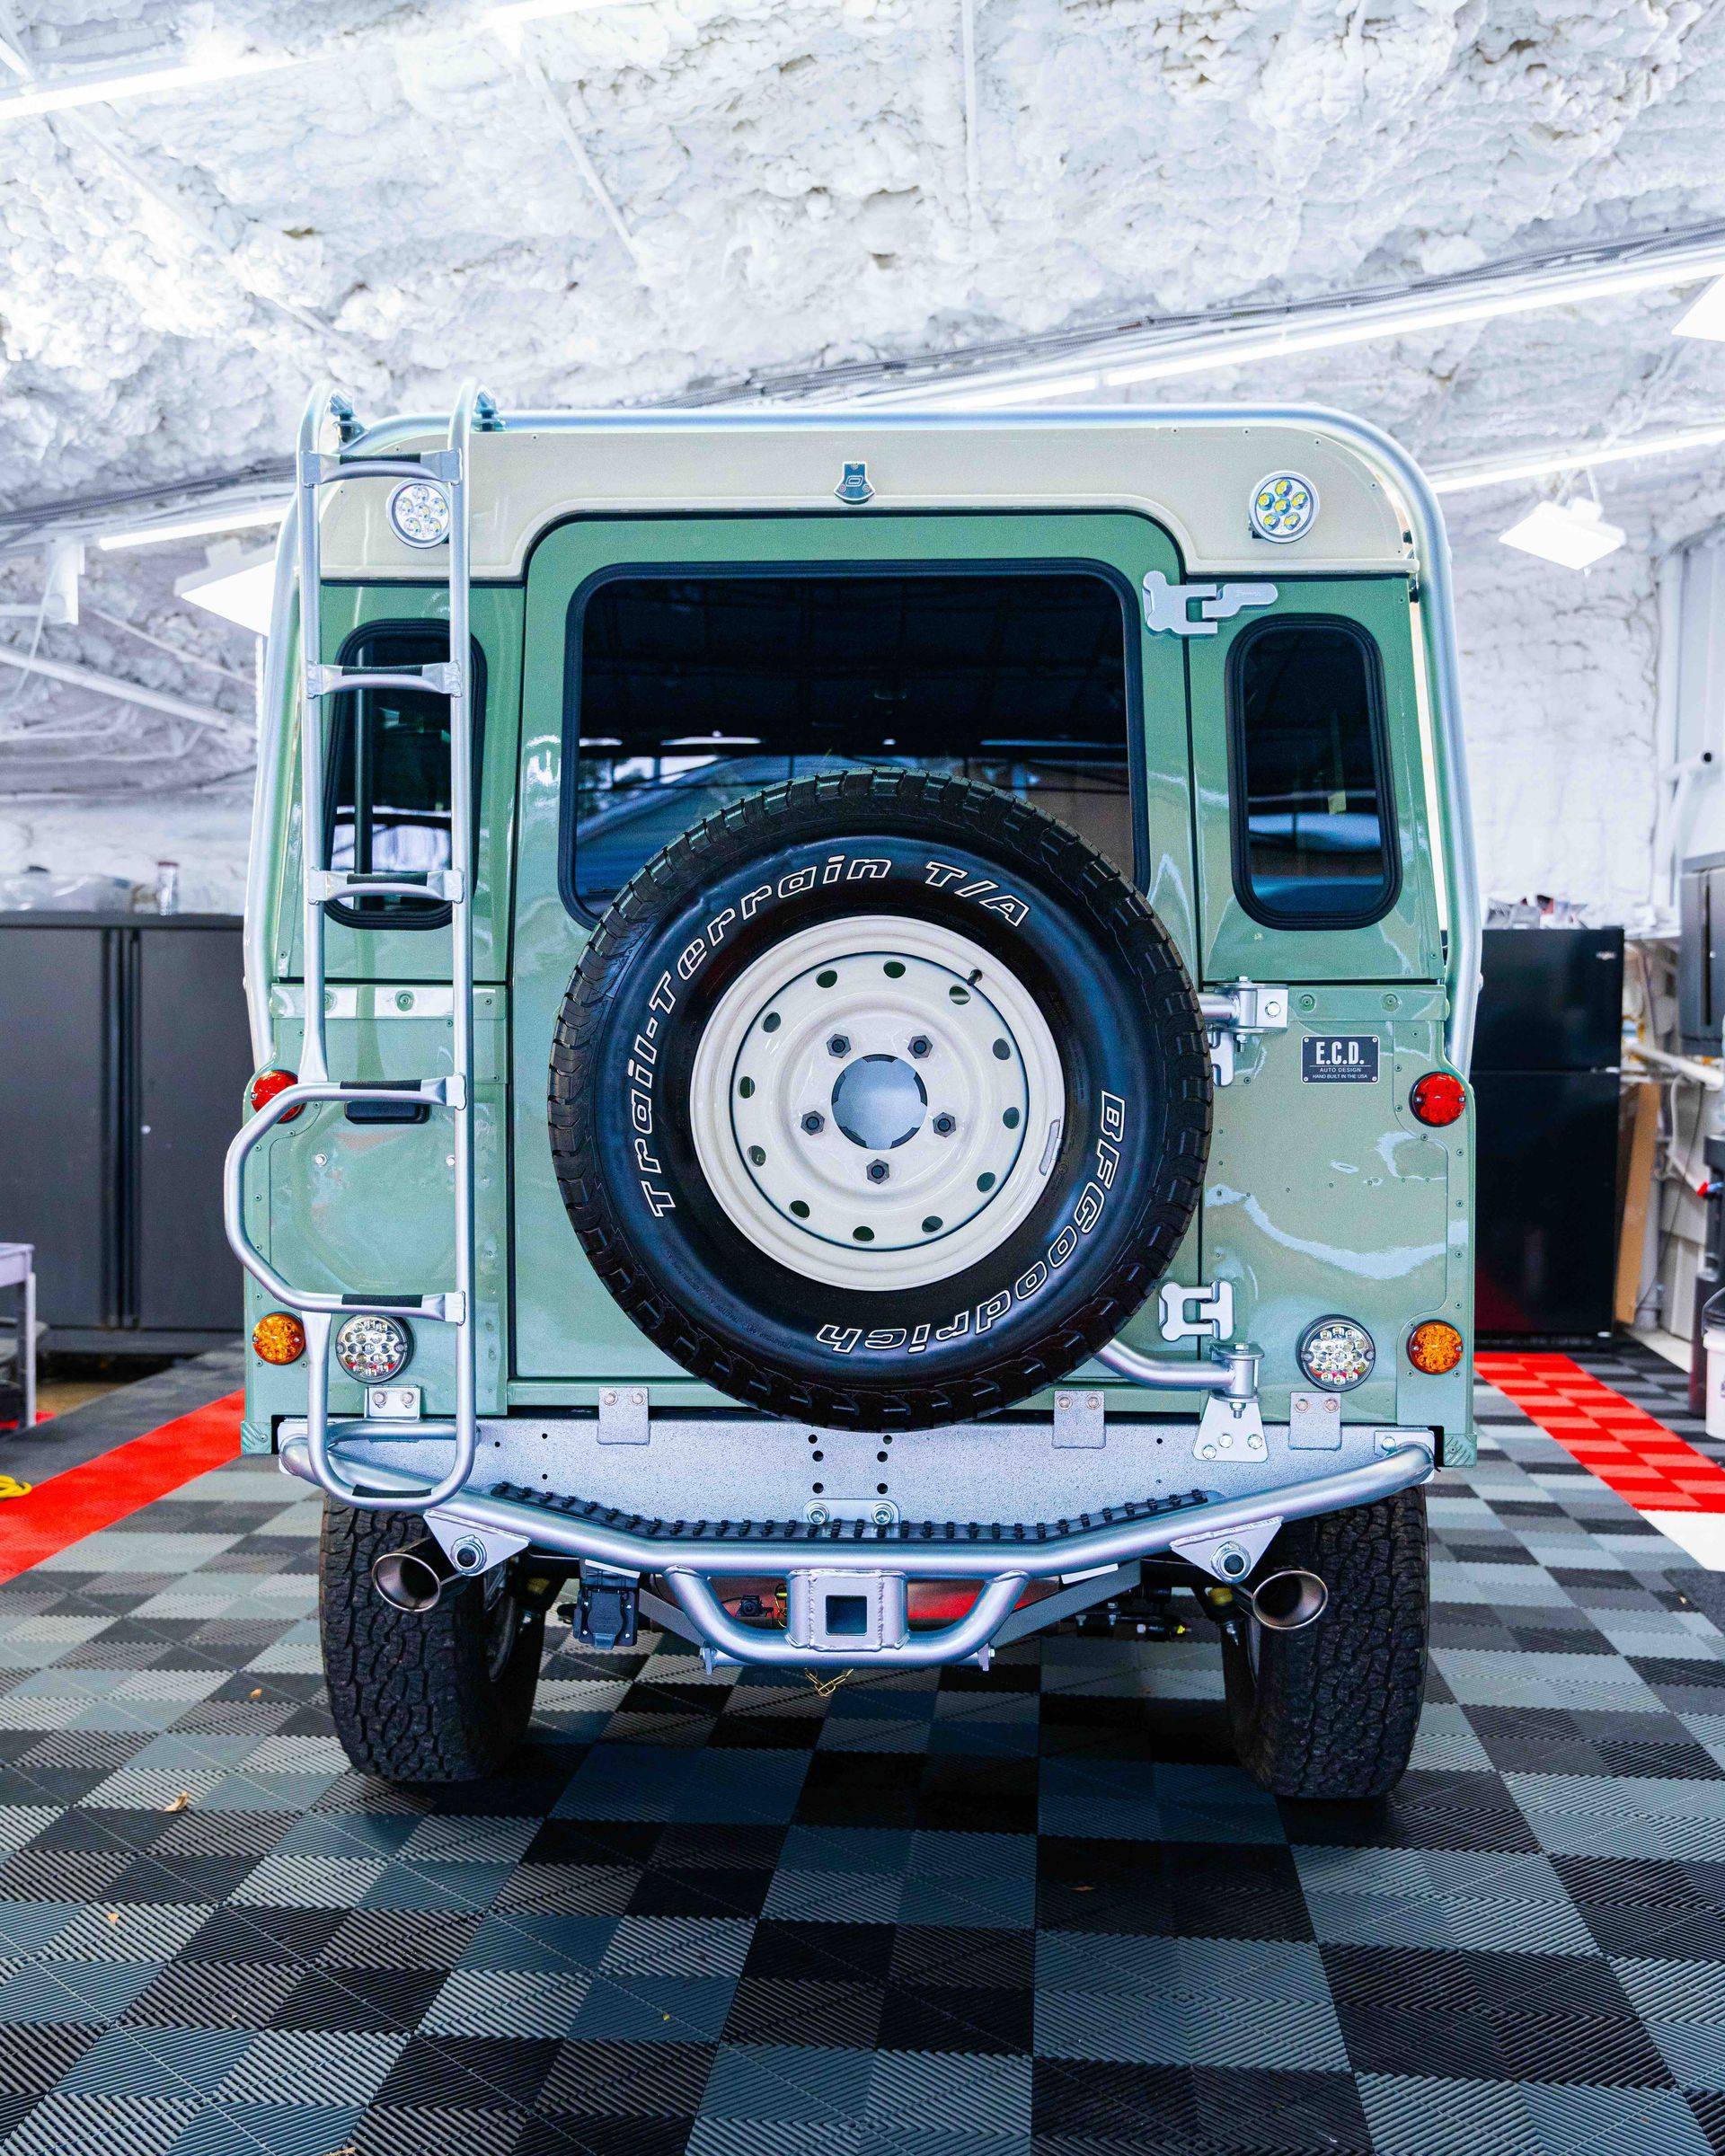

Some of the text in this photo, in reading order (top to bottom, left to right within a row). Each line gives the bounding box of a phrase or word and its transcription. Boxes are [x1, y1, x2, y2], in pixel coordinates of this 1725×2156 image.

[627, 854, 893, 1217] Trail-Terrain
[925, 861, 1031, 927] T/A
[1315, 1040, 1365, 1065] E.C.D.
[815, 1090, 1126, 1355] BFGoodrich
